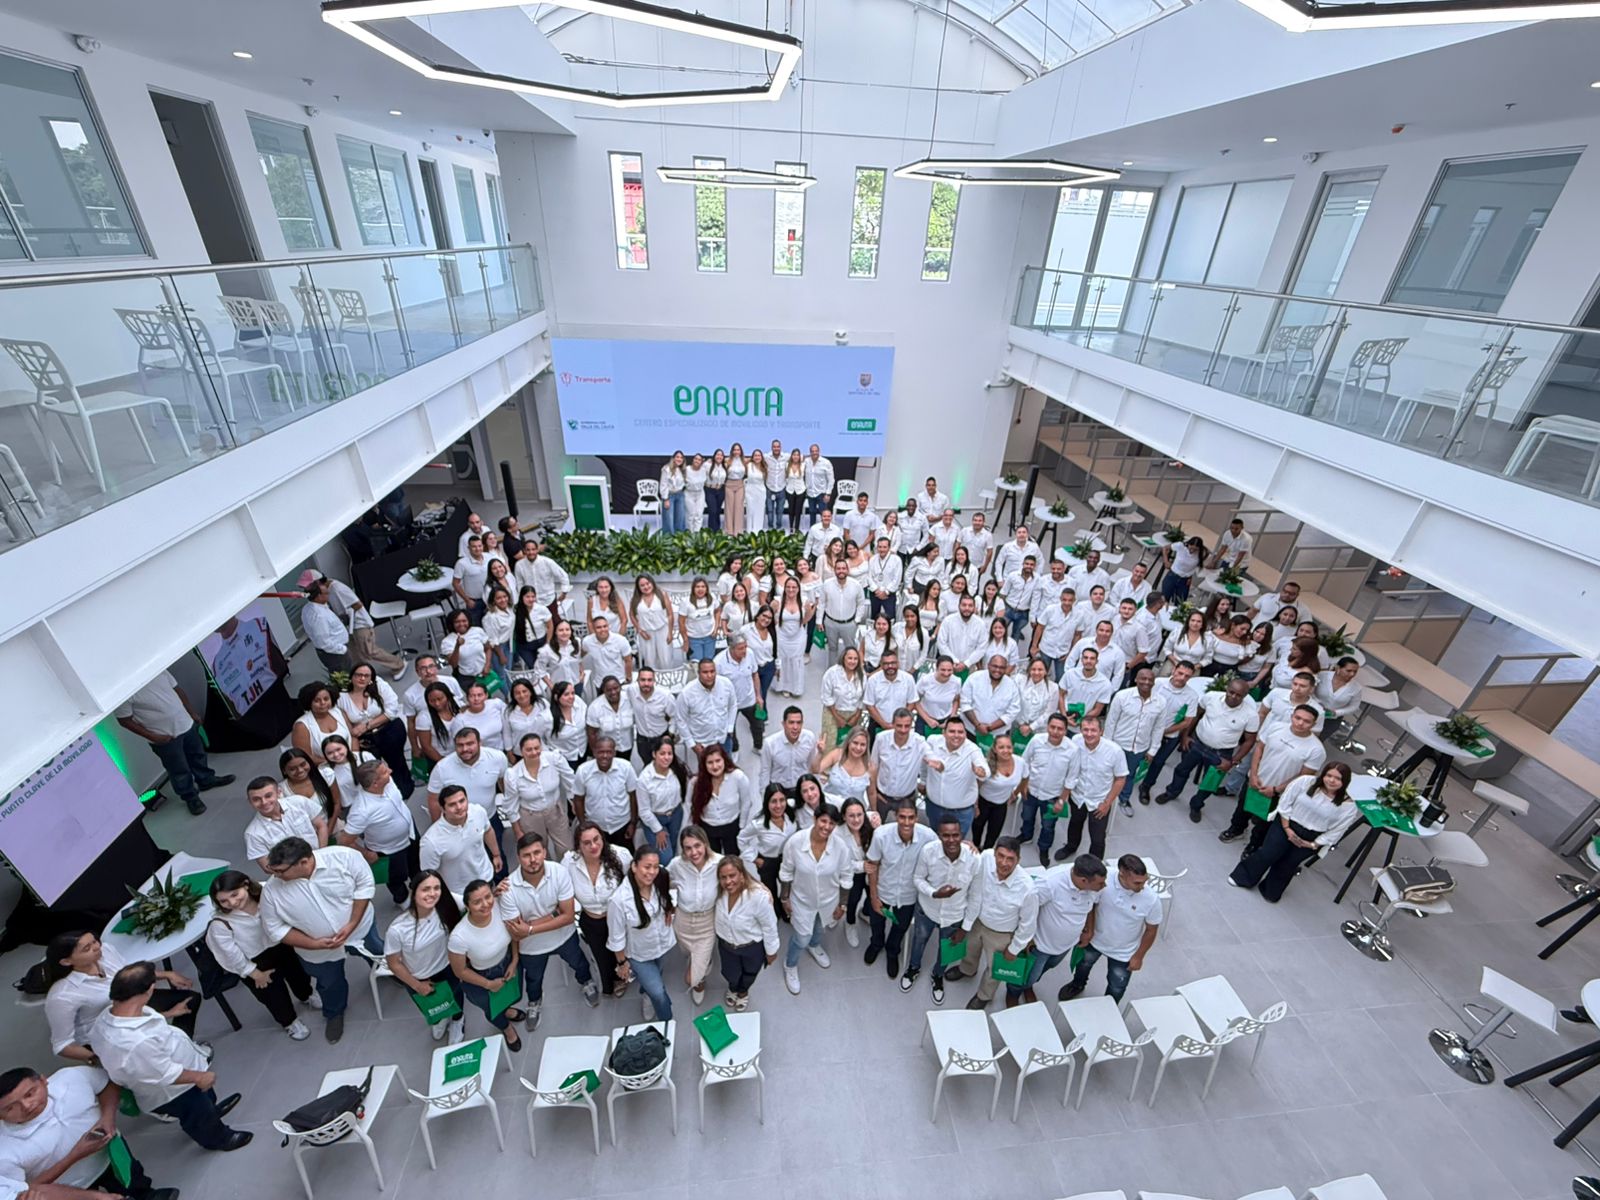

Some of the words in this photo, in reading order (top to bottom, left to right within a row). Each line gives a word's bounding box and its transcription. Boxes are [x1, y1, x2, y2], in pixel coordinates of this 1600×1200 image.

[241, 679, 264, 705] TJH
[1, 796, 25, 818] PUNTO
[24, 779, 45, 799] CLAVE
[44, 772, 55, 782] DE
[53, 764, 63, 774] LA
[62, 739, 93, 767] MOVILIDAD
